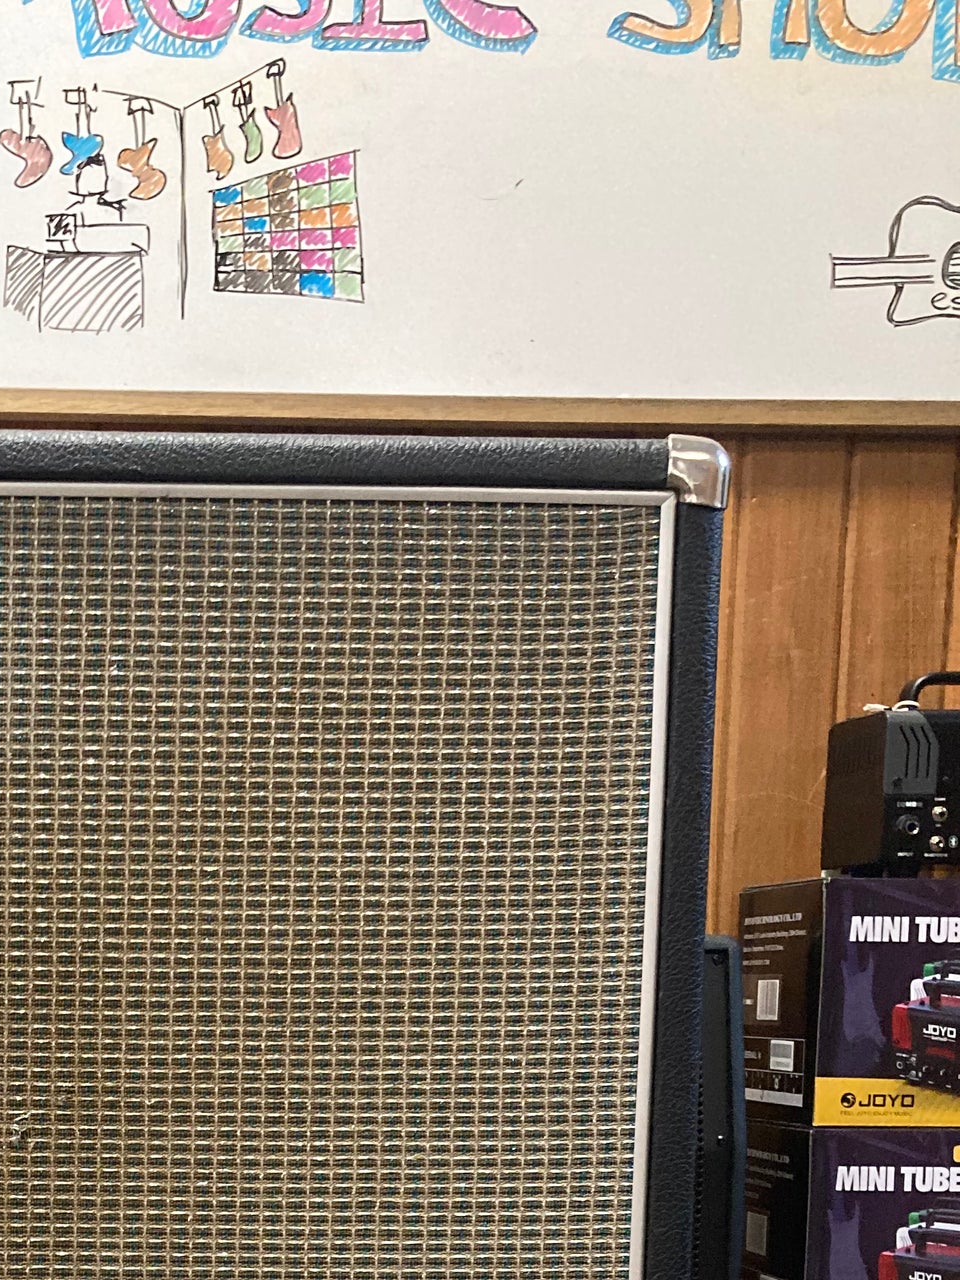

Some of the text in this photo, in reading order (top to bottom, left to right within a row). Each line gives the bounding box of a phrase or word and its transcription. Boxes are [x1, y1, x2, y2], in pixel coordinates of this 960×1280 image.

[849, 915, 910, 942] MINI
[923, 1024, 957, 1038] JOYO
[858, 1094, 915, 1108] JOYO
[835, 1165, 960, 1193] MINI TUBE
